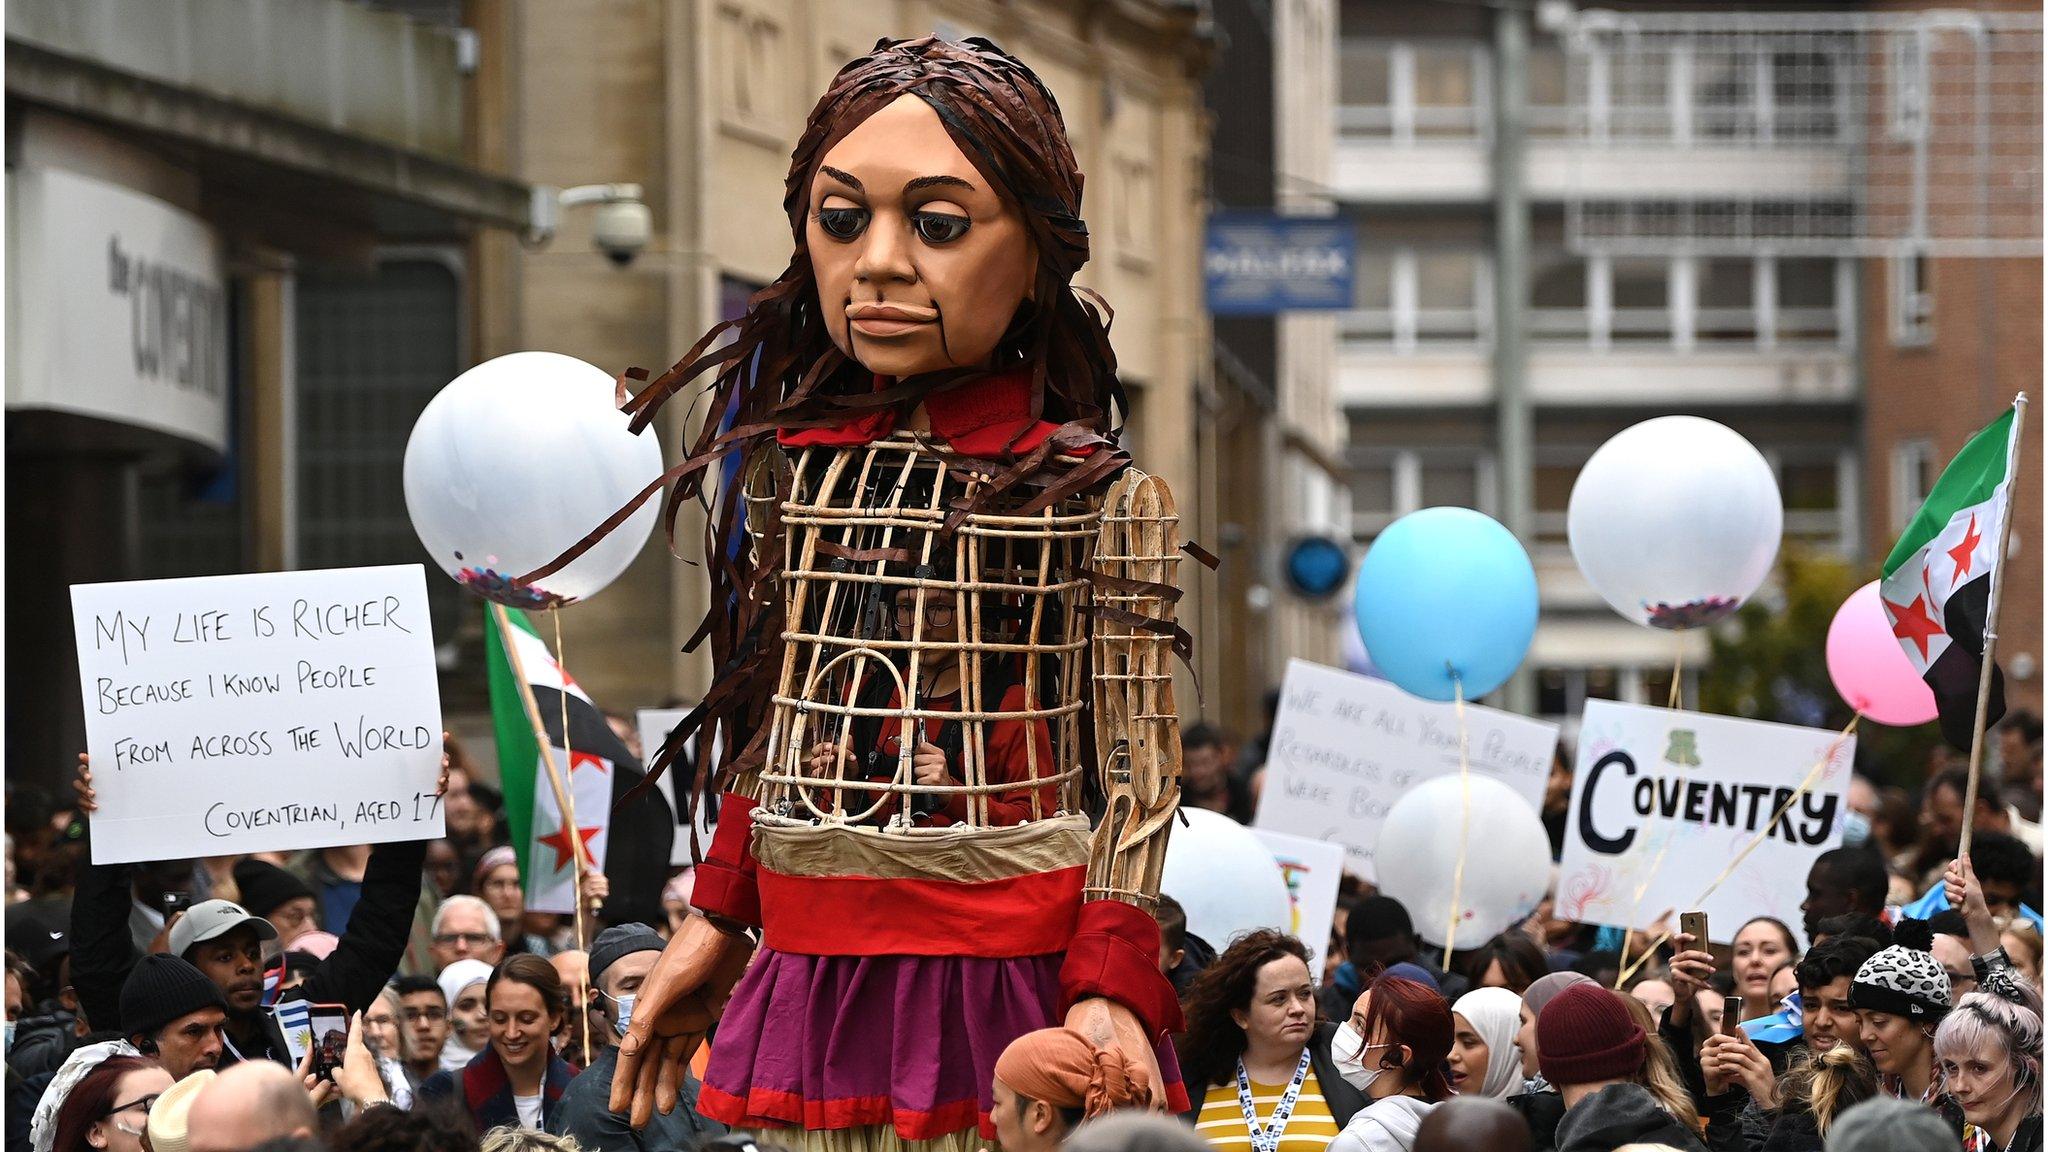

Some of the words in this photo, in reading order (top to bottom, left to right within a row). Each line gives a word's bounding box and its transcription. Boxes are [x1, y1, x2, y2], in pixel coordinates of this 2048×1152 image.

[96, 610, 150, 665] MY
[173, 610, 232, 644] LIFE
[253, 606, 275, 637] IS
[293, 596, 412, 640] RICHER
[97, 677, 193, 715] BECAUSE
[209, 674, 215, 698] I
[223, 673, 280, 698] KNOW
[297, 660, 377, 694] PEOPLE
[114, 737, 174, 771] FROM
[190, 730, 273, 760] ACROSS
[287, 726, 321, 752] THE
[334, 714, 431, 759] WORLD
[204, 802, 346, 837] COVENTRIAN,
[354, 800, 401, 825] AGED
[412, 792, 441, 822] 17
[1579, 750, 1839, 854] COVENTRY
